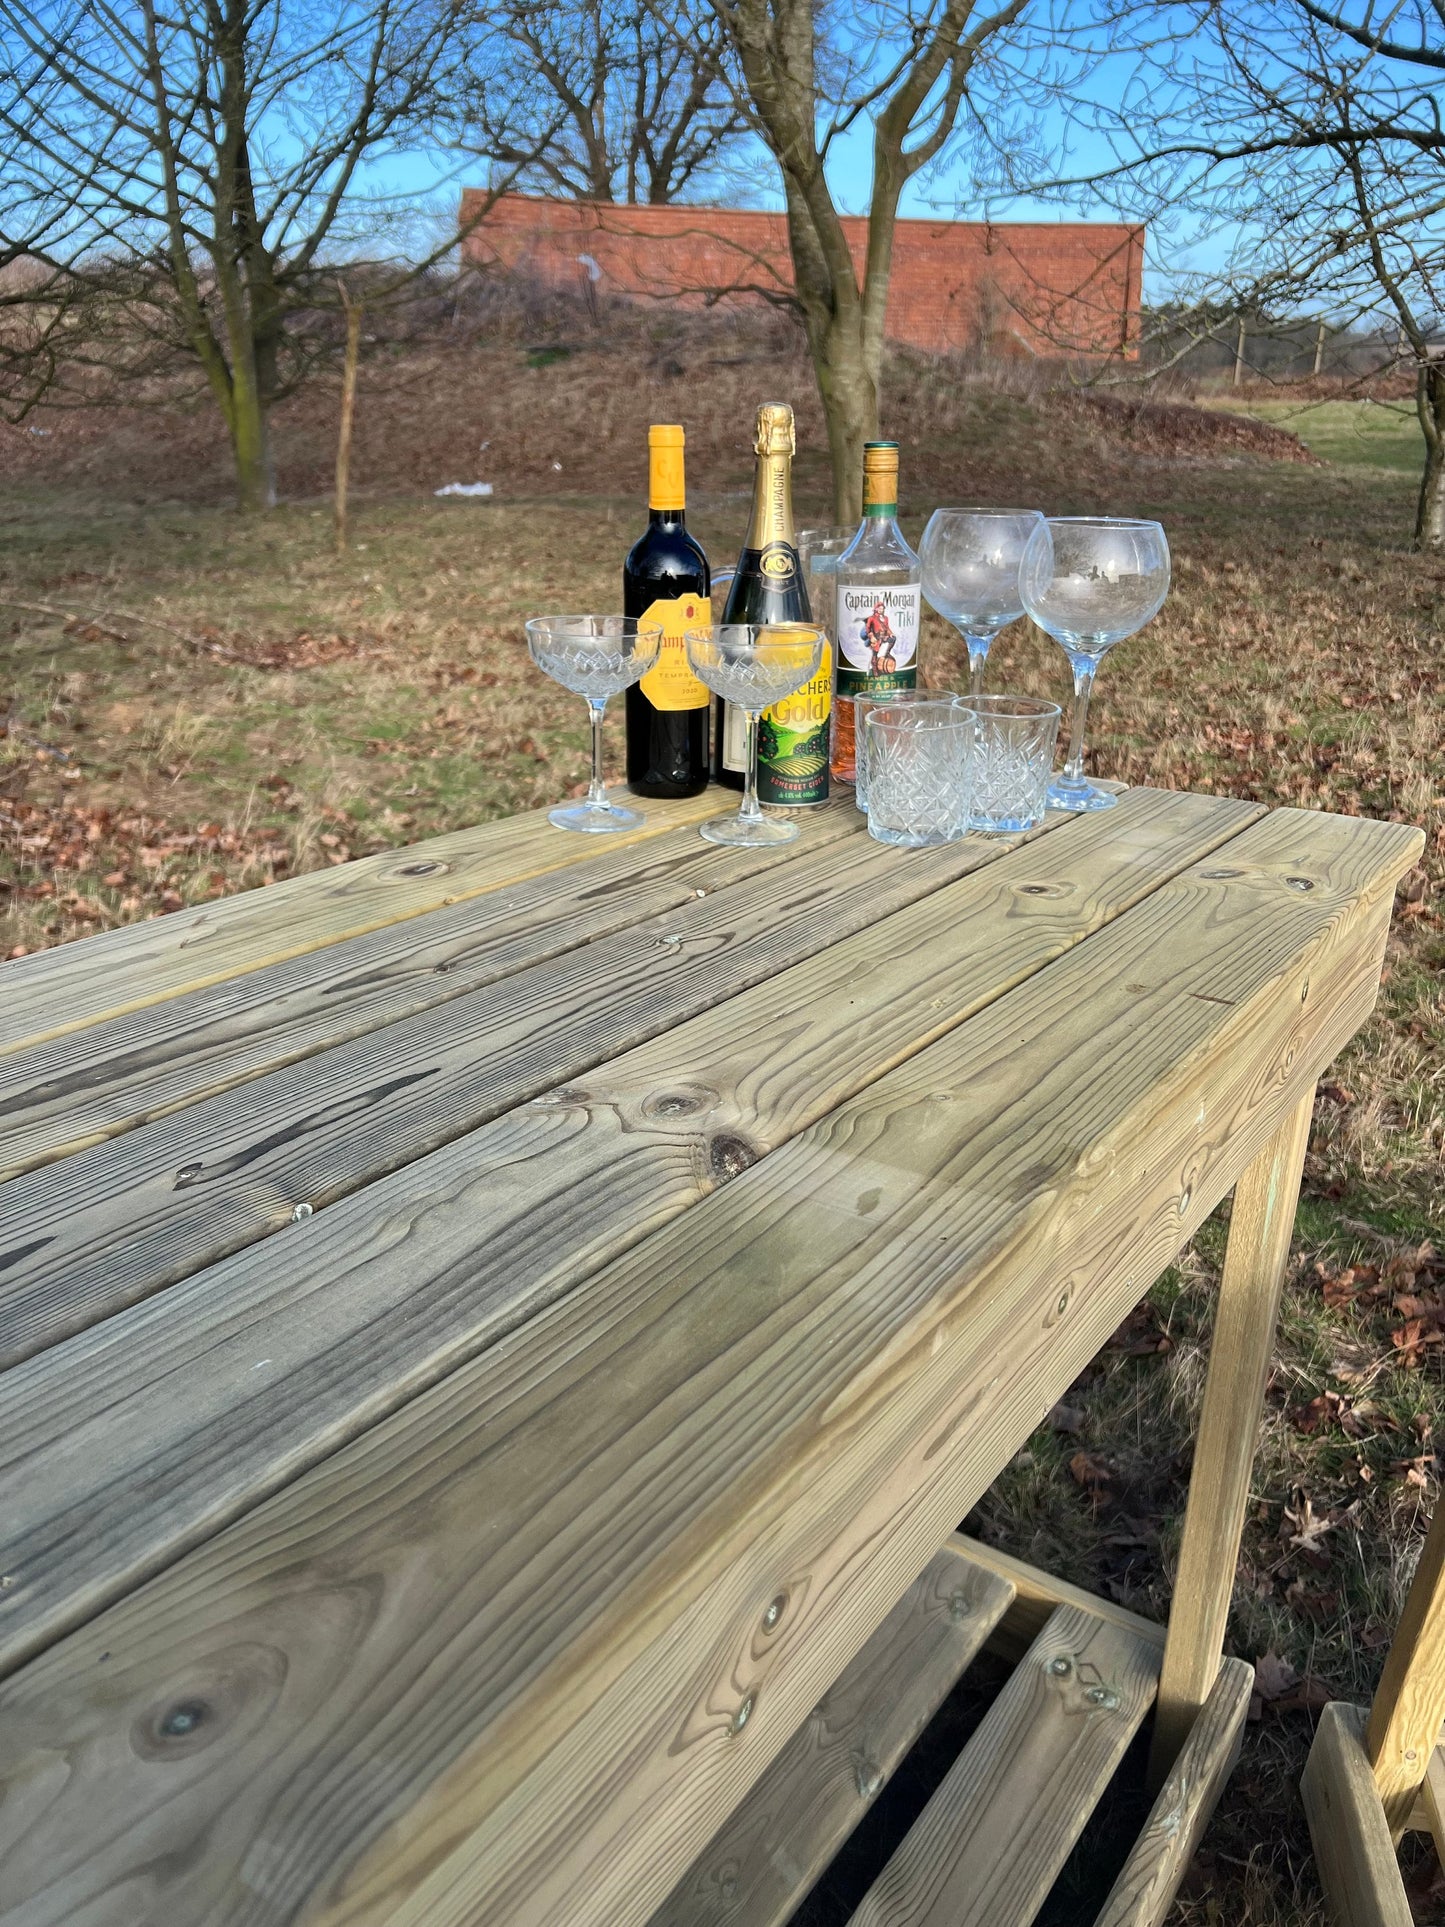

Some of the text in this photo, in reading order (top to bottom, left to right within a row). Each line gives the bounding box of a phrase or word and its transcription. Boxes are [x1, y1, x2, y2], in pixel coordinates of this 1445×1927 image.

[773, 466, 785, 532] CHAMPAGNE
[845, 592, 915, 611] Captain Morgan
[895, 612, 914, 627] Tiki
[849, 680, 908, 692] PINEAPPLE
[771, 697, 824, 726] Gold
[770, 776, 807, 791] SOMERSET
[808, 775, 825, 789] CIDER
